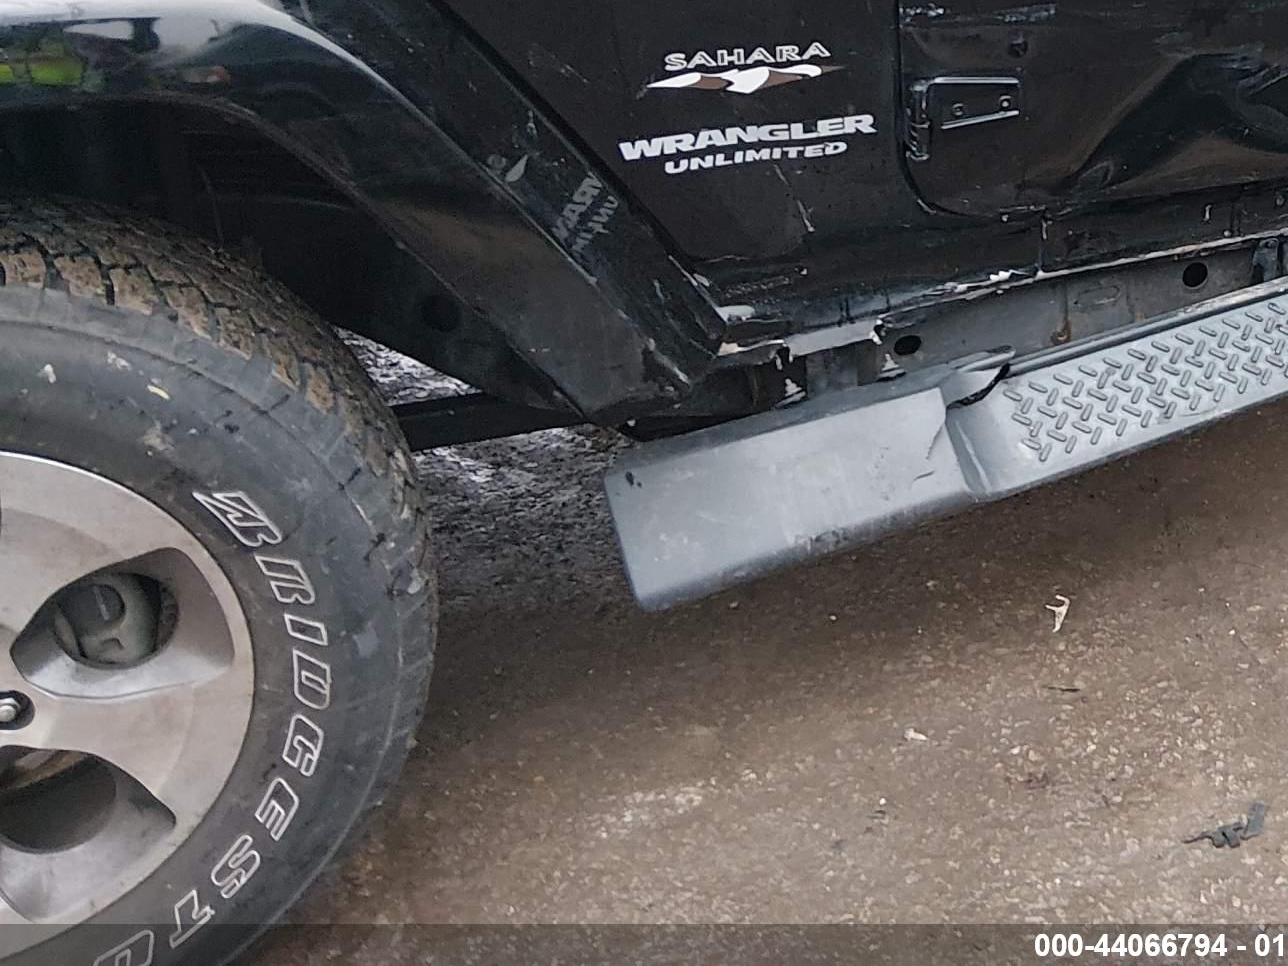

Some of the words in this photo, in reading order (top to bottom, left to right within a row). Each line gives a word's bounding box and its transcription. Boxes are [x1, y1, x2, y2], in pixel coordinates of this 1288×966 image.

[664, 42, 832, 72] SAHARA
[619, 114, 878, 161] WRANGLER
[664, 141, 848, 175] UNLIMITED
